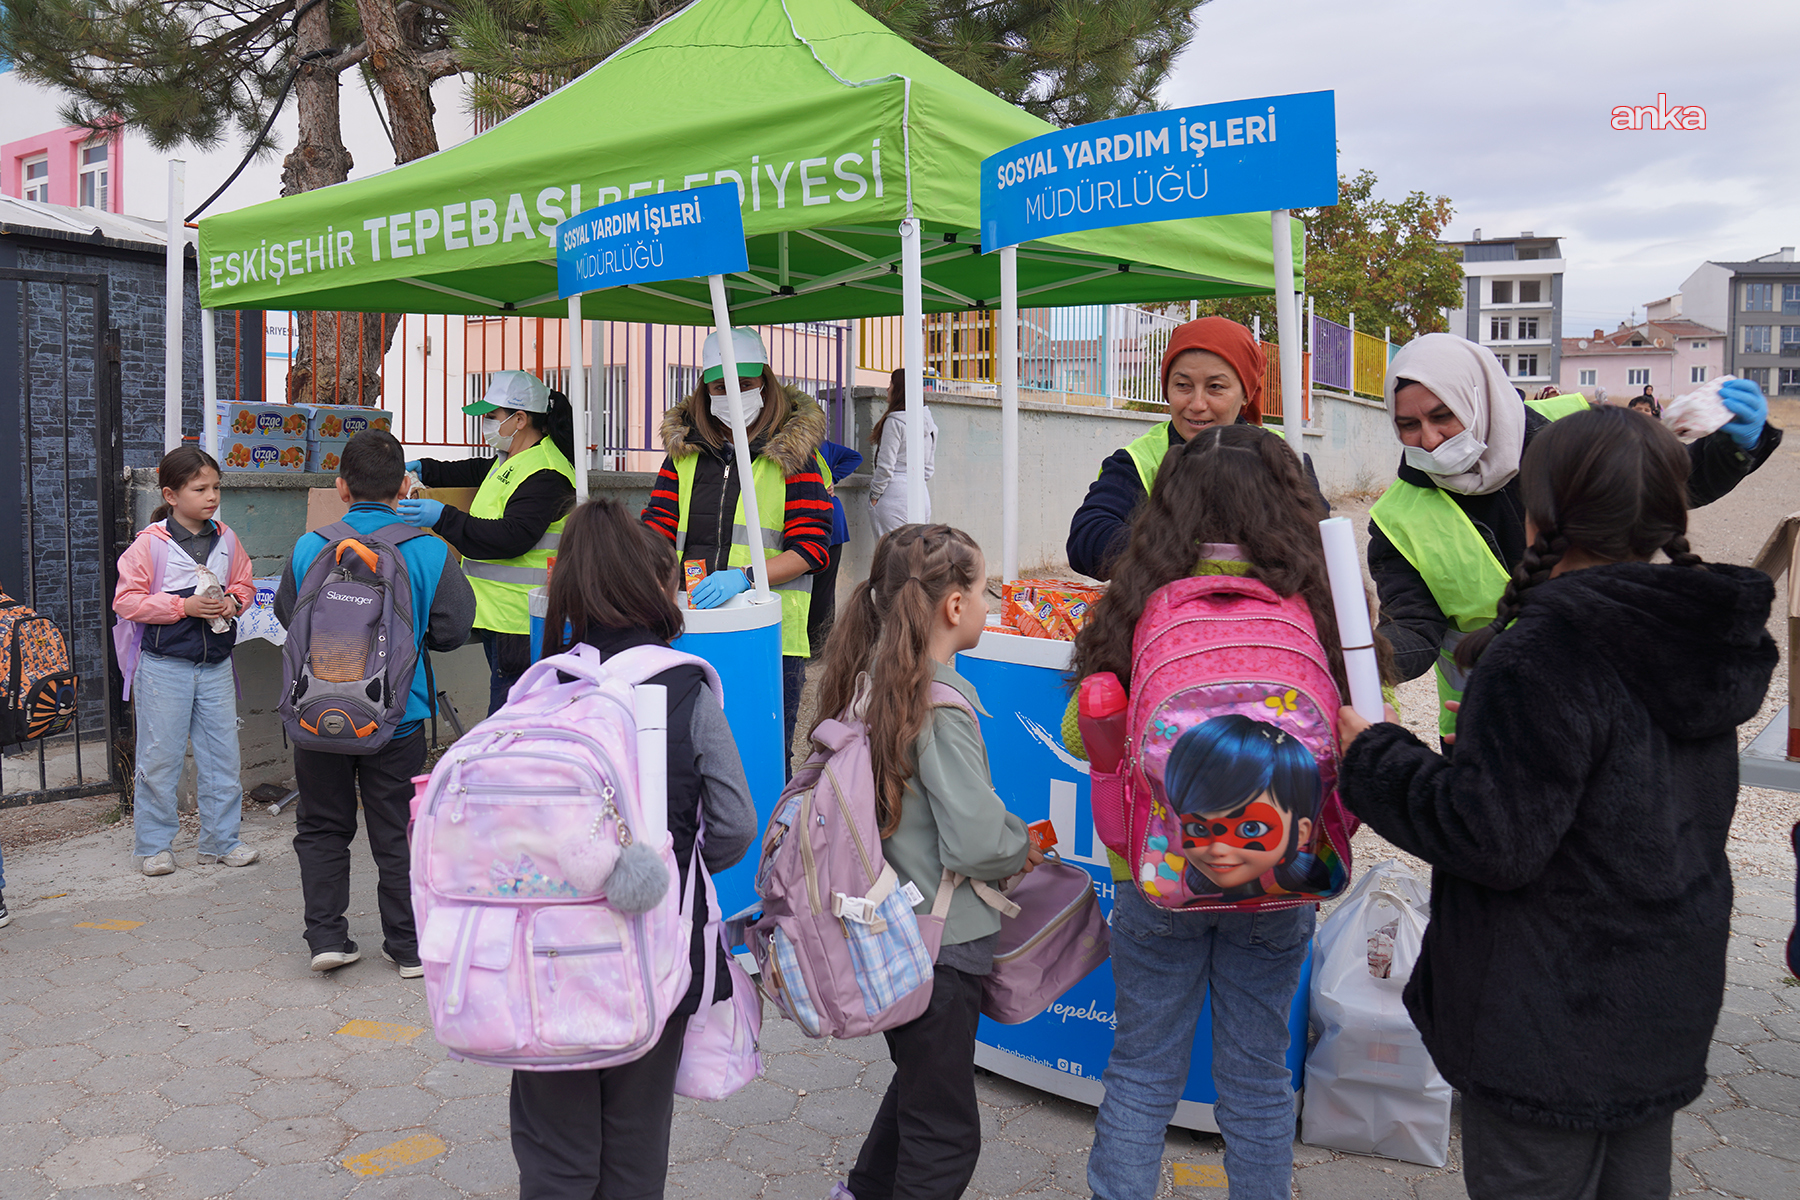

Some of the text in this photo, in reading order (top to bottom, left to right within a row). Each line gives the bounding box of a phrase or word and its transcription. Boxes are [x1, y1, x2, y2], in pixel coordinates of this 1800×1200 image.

[997, 105, 1276, 190] SOSYAL YARDIM İŞLERİ
[1026, 163, 1209, 224] MÜDÜRLÜĞÜ
[563, 195, 702, 252] SOSYAL YARDIM İŞLERİ
[210, 225, 355, 289] ESKİŞEHİR
[576, 239, 664, 281] MÜDÜRLÜĞÜ
[260, 414, 281, 429] özge
[345, 417, 366, 432] özge
[254, 447, 277, 462] özge
[326, 590, 373, 605] Slazenger
